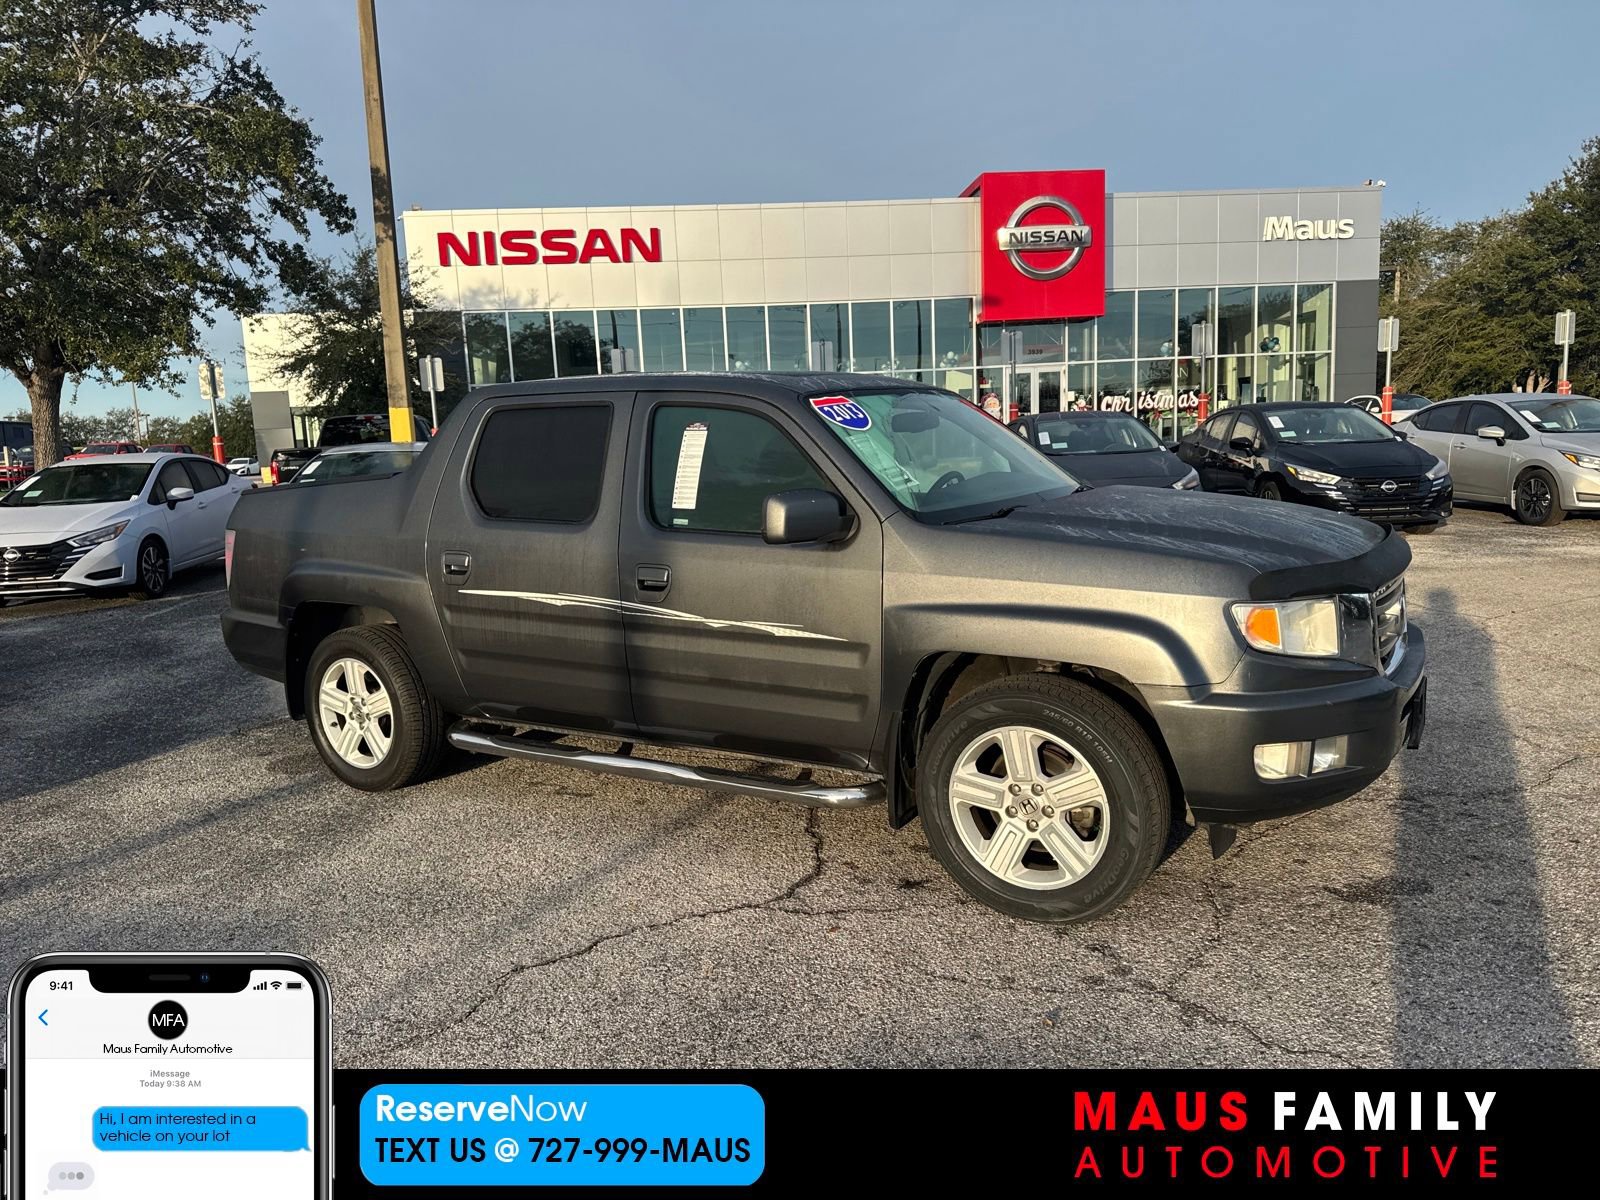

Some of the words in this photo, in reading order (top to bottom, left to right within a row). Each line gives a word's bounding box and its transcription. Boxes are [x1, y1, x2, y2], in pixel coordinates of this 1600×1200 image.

[1007, 227, 1086, 245] NISSAN
[1263, 215, 1356, 241] Maus
[437, 227, 662, 267] NISSAN
[823, 403, 865, 422] 2013
